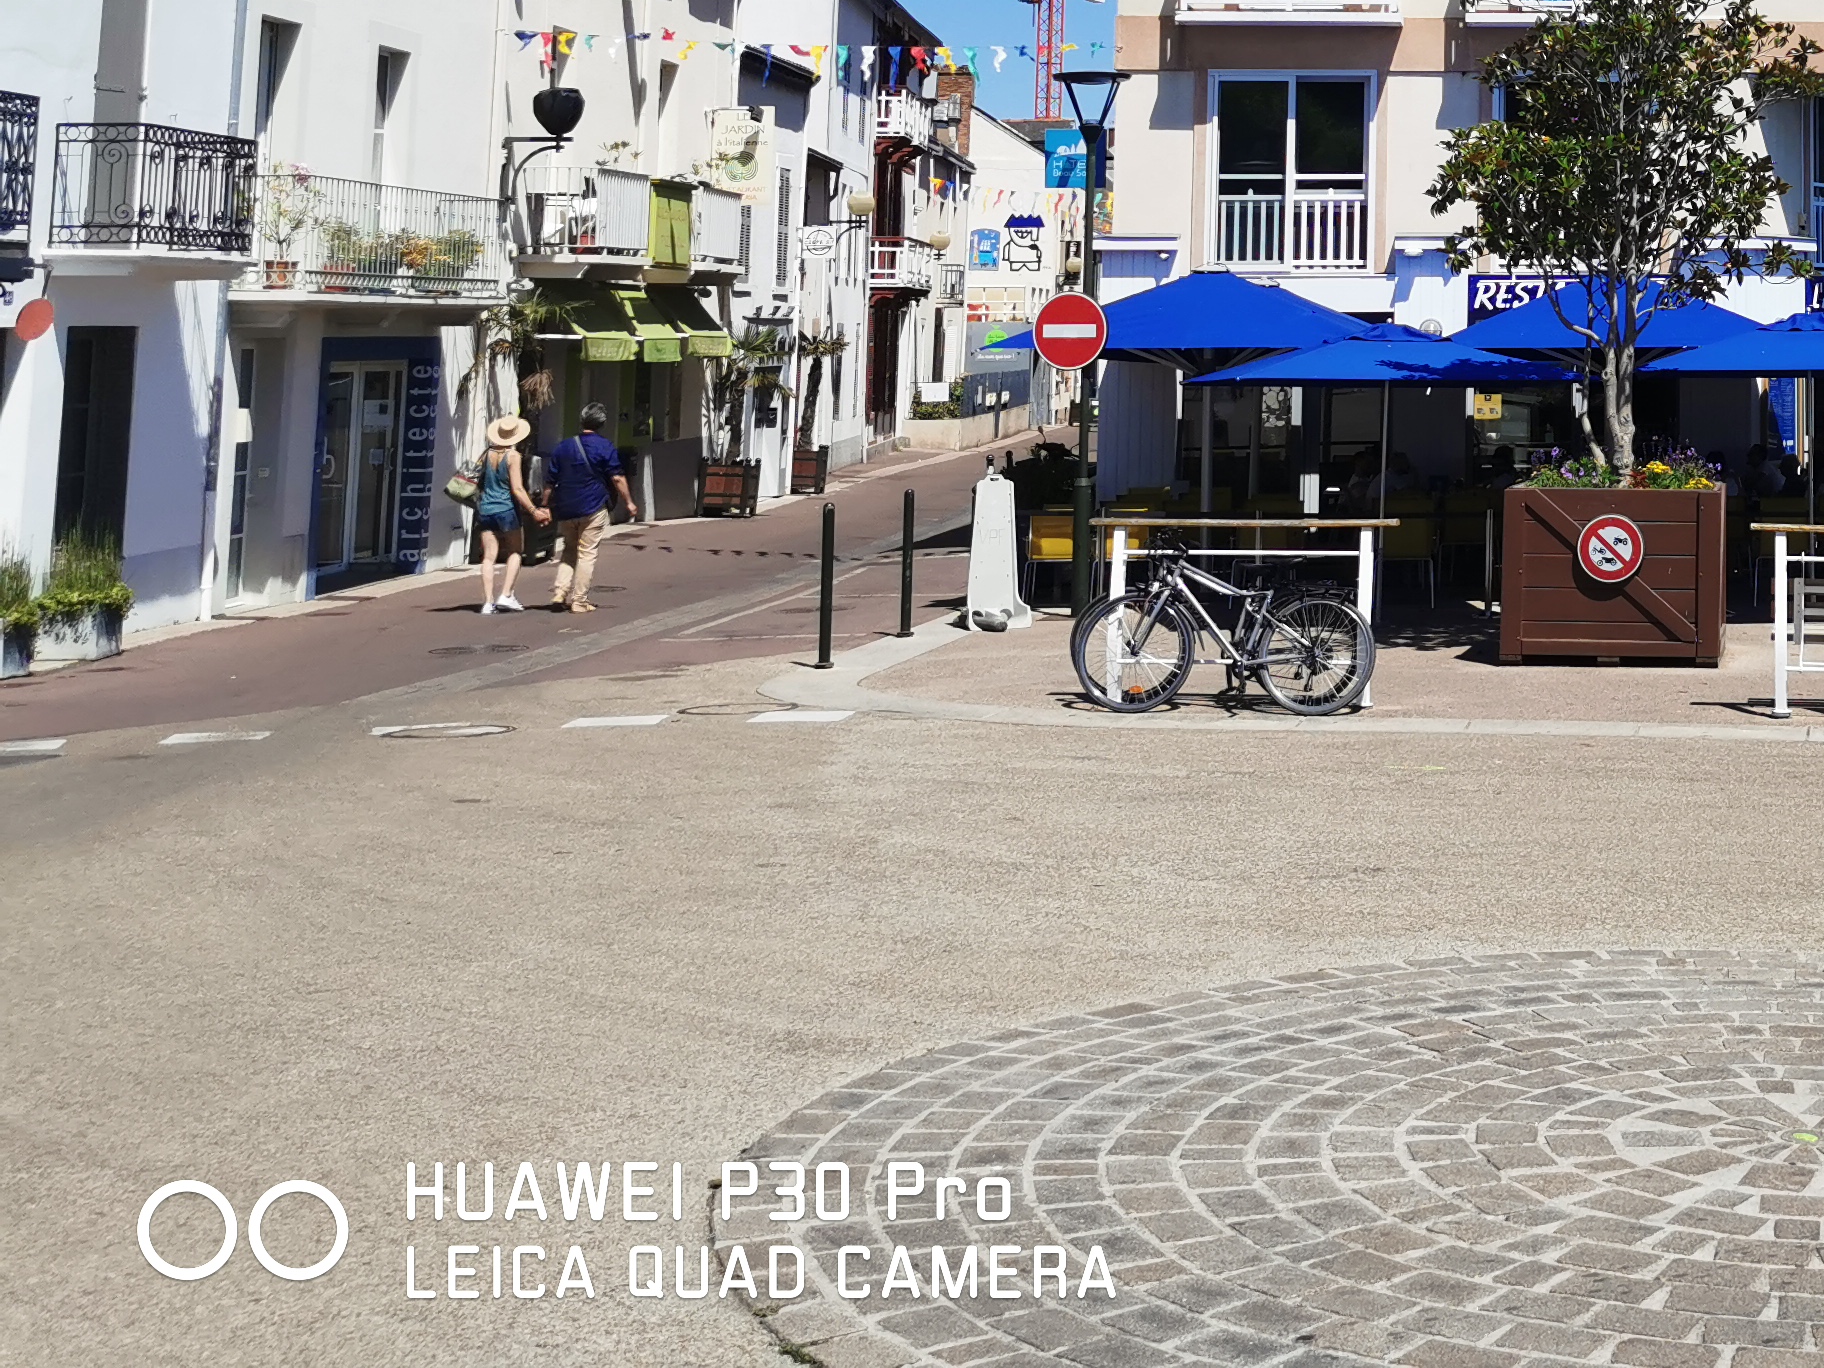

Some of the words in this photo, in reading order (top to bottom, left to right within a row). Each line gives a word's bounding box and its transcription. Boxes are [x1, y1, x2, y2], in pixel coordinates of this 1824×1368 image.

[721, 125, 766, 135] JARDIN
[725, 137, 769, 147] l'italienne
[399, 365, 433, 562] architecte
